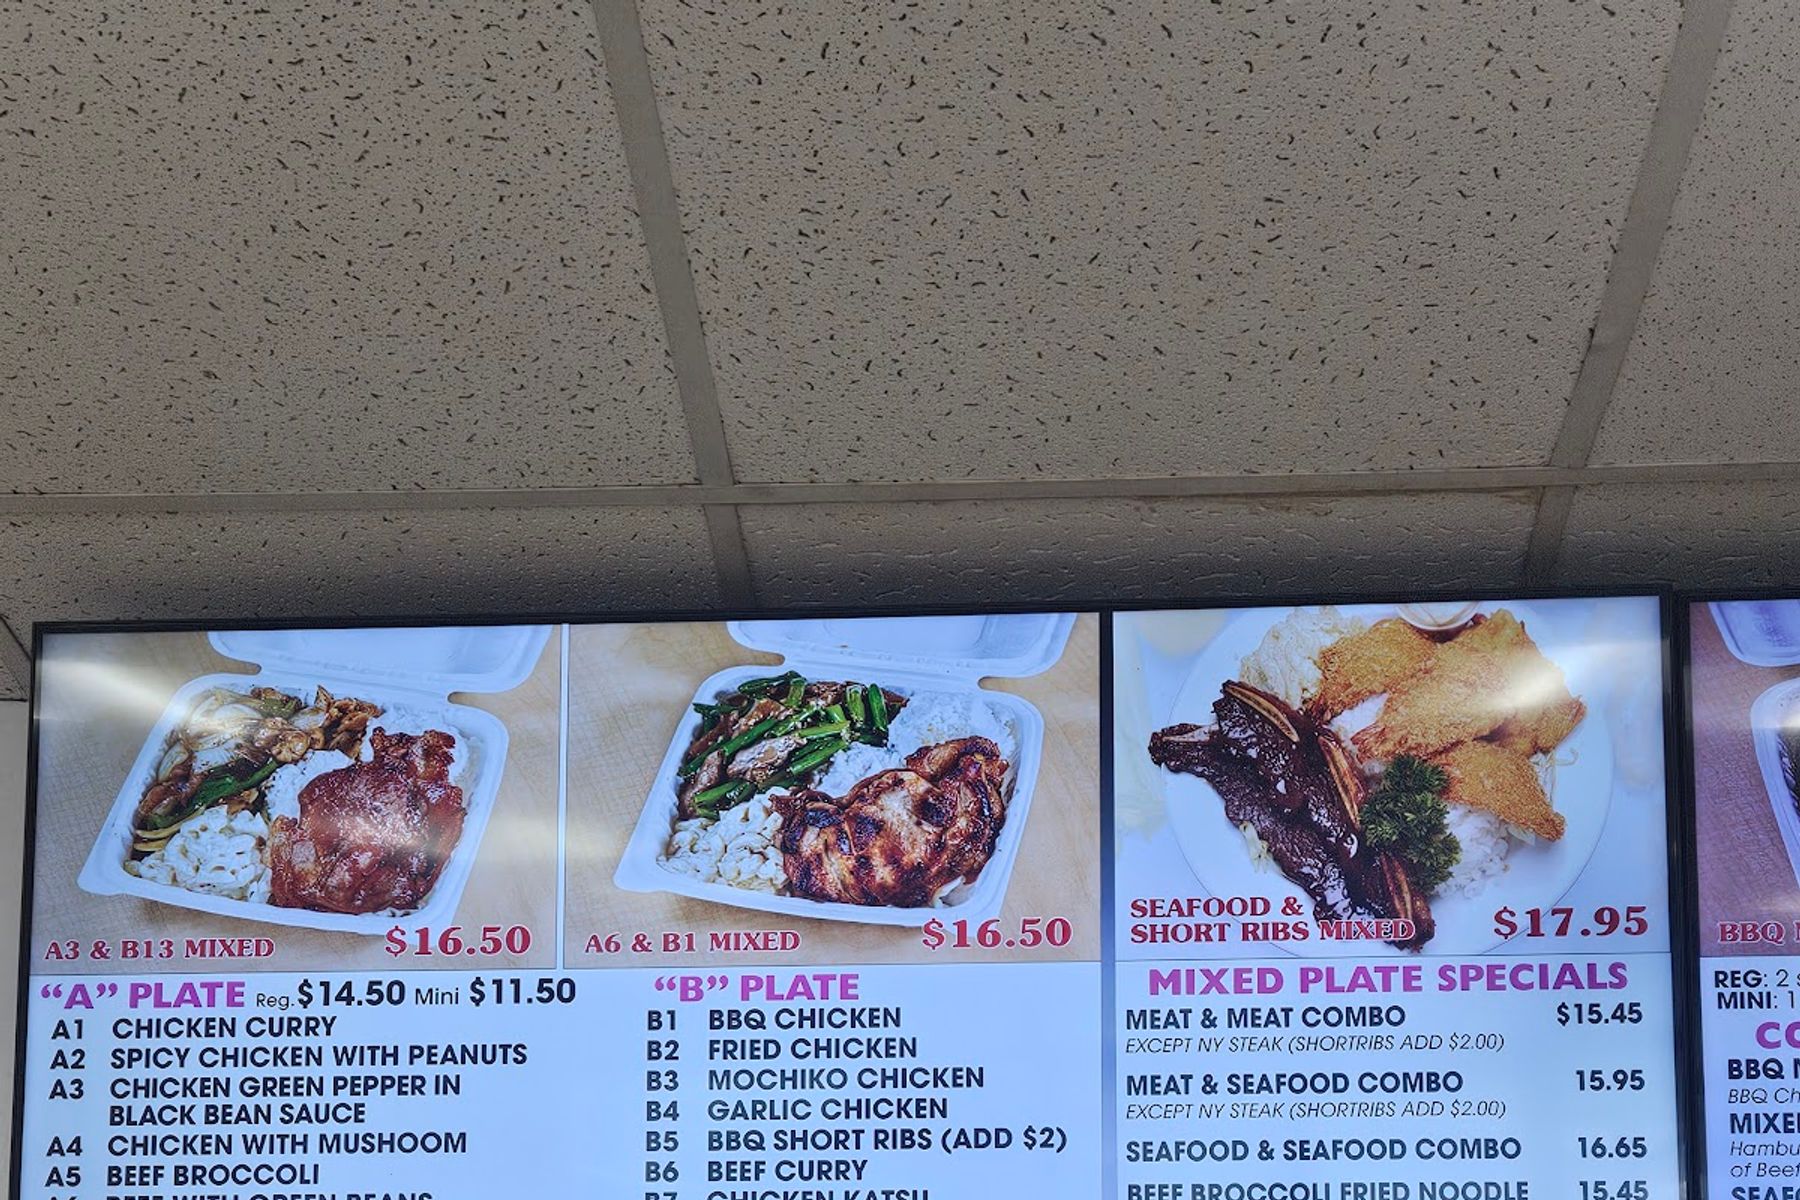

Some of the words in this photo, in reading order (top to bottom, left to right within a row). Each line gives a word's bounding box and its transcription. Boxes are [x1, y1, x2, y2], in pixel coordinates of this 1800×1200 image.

[1131, 897, 1270, 918] SEAFOOD
[1282, 897, 1303, 918] &
[921, 918, 1072, 949] $16.50
[1130, 919, 1231, 944] SHORT
[1241, 919, 1309, 944] RIBS
[1319, 919, 1415, 944] MIXED
[1494, 906, 1648, 941] $17.95
[1718, 922, 1784, 944] BBQ
[45, 938, 80, 960] A3
[90, 938, 113, 960] &
[121, 938, 173, 960] B13
[184, 938, 274, 960] MIXED
[385, 925, 532, 957] $16.50
[585, 932, 620, 953] A6
[632, 932, 653, 953] &
[662, 932, 696, 953] B1
[709, 932, 800, 953] MIXED
[741, 974, 859, 1001] PLATE
[1150, 968, 1284, 996] MIXED
[1300, 966, 1422, 993] PLATE
[1439, 962, 1627, 991] SPECIALS
[1715, 970, 1767, 988] REG:
[1776, 969, 1789, 987] 2
[129, 982, 245, 1008] PLATE
[257, 993, 294, 1010] Reg.
[298, 979, 405, 1009] $14.50
[416, 988, 458, 1005] Mini
[470, 978, 575, 1007] $11.50
[1717, 991, 1778, 1010] MINI:
[1788, 991, 1794, 1008] 1
[51, 1019, 82, 1039] A1
[113, 1017, 236, 1039] CHICKEN
[246, 1016, 337, 1037] CURRY
[648, 1010, 675, 1030] B1
[710, 1009, 766, 1030] BBQ
[775, 1007, 900, 1029] CHICKEN
[1127, 1009, 1192, 1030] MEAT
[1201, 1008, 1217, 1028] &
[1228, 1008, 1293, 1028] MEAT
[1302, 1005, 1405, 1027] COMBO
[1557, 1002, 1642, 1026] $15.45
[1126, 1038, 1192, 1053] EXCEPT
[1198, 1037, 1224, 1052] NY
[1229, 1037, 1283, 1052] STEAK
[1289, 1035, 1394, 1054] (SHORTRIBS
[1400, 1035, 1442, 1049] ADD
[1449, 1032, 1504, 1052] $2.00)
[1728, 1058, 1784, 1079] BBQ
[49, 1079, 83, 1099] A3
[110, 1077, 230, 1099] CHICKEN
[239, 1076, 323, 1097] GREEN
[333, 1075, 426, 1096] PEPPER
[435, 1075, 460, 1095] IN
[1728, 1088, 1767, 1103] BBQ
[110, 1105, 196, 1126] BLACK
[204, 1104, 271, 1124] BEAN
[280, 1103, 365, 1124] SAUCE
[1127, 1104, 1193, 1119] EXCEPT
[1199, 1104, 1225, 1118] NY
[1230, 1103, 1285, 1118] STEAK
[1290, 1101, 1396, 1120] (SHORTRIBS
[1401, 1101, 1444, 1116] ADD
[1451, 1099, 1505, 1118] $2.00)
[646, 1131, 678, 1151] B5
[708, 1130, 765, 1151] BBQ
[774, 1129, 865, 1151] SHORT
[874, 1128, 932, 1150] RIBS
[941, 1128, 1012, 1154] (ADD
[1024, 1125, 1067, 1153] $2)
[1127, 1140, 1249, 1162] SEAFOOD
[1258, 1140, 1274, 1160] &
[1283, 1139, 1406, 1161] SEAFOOD
[1416, 1137, 1521, 1160] COMBO
[1578, 1137, 1647, 1158] 16.65
[1731, 1163, 1751, 1177] of
